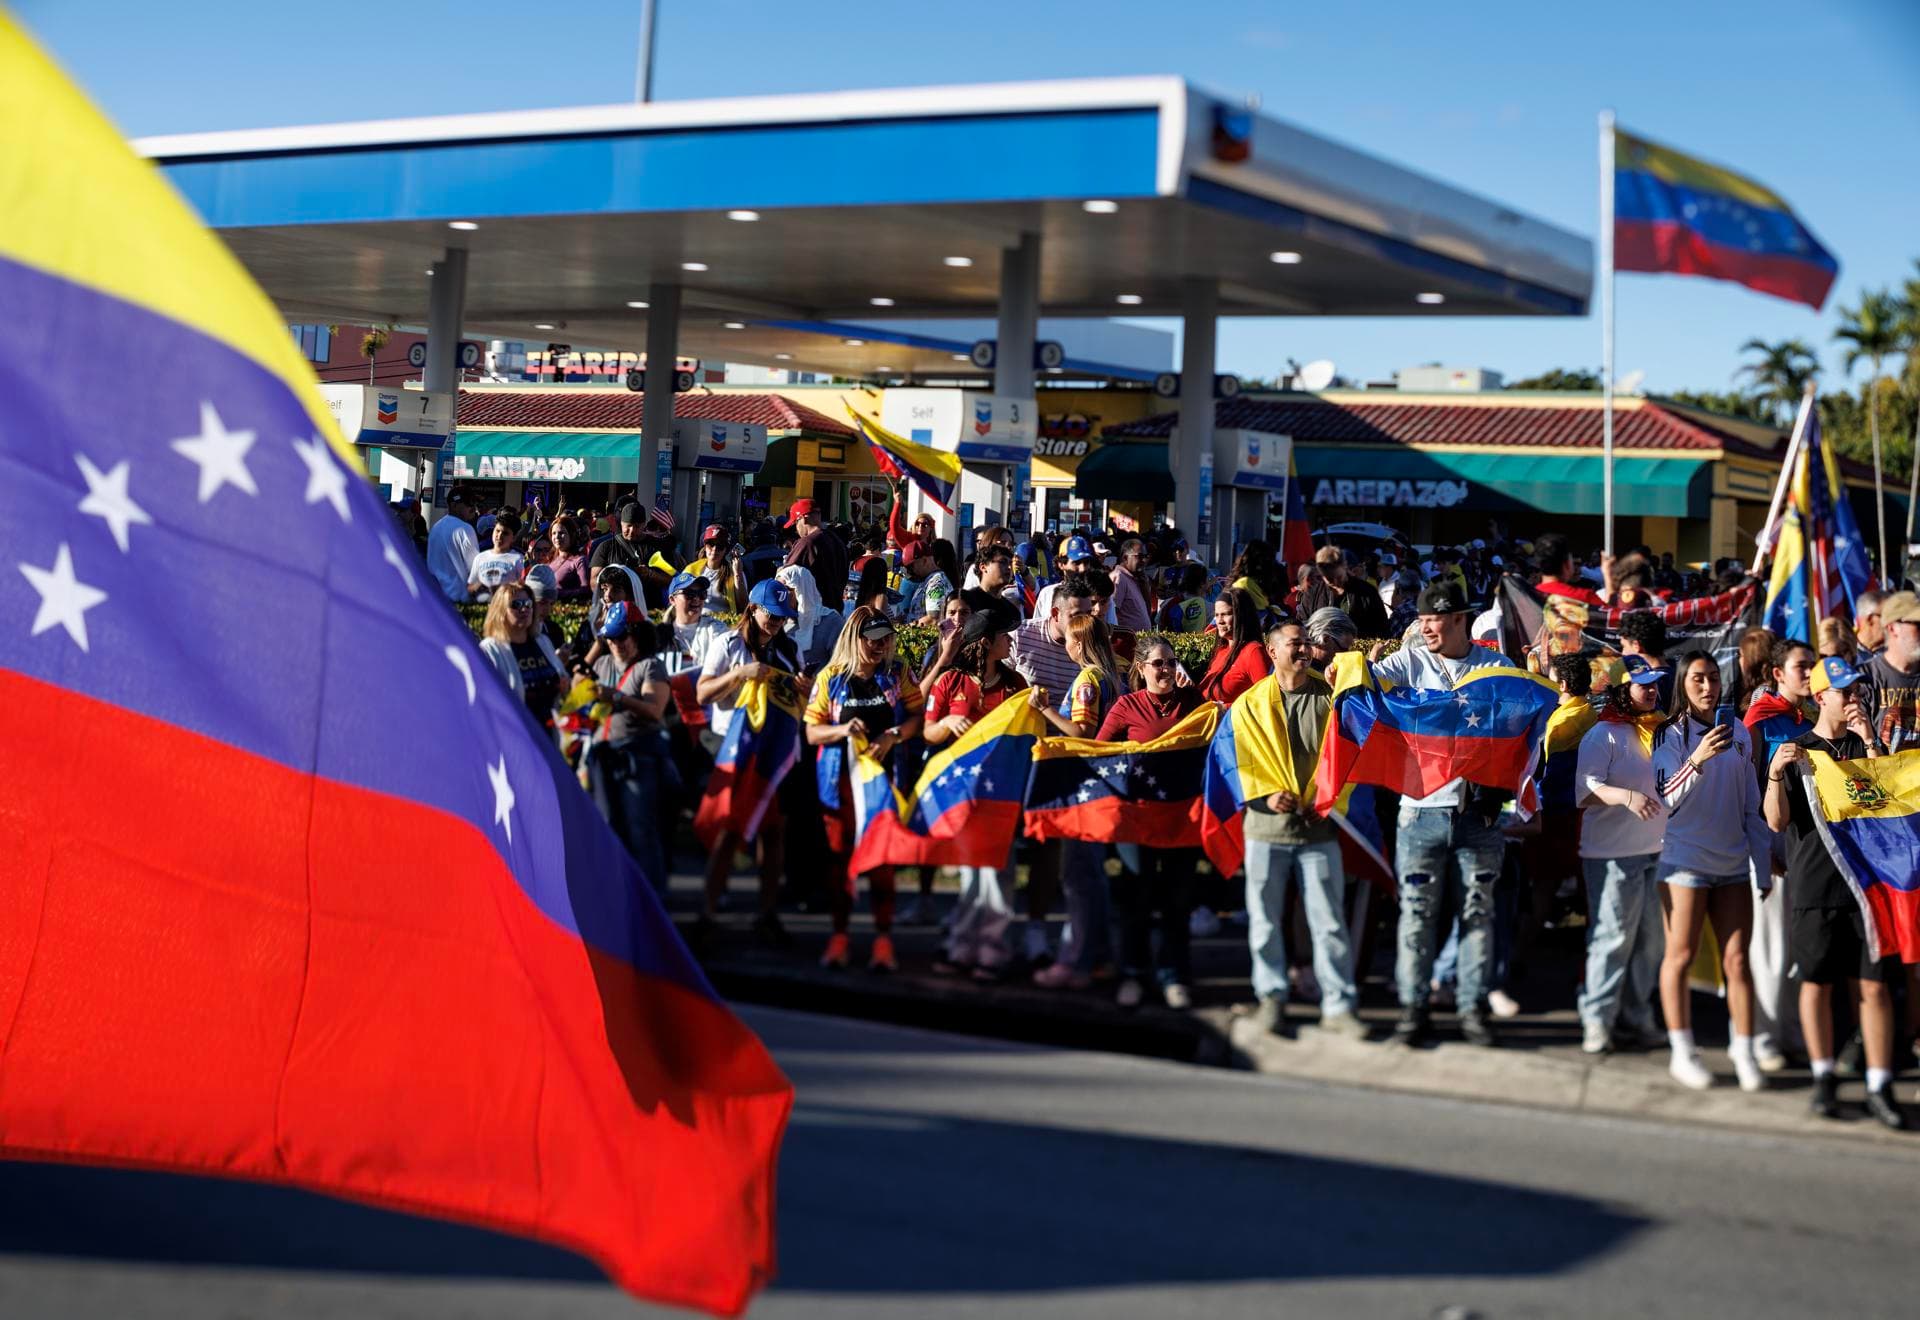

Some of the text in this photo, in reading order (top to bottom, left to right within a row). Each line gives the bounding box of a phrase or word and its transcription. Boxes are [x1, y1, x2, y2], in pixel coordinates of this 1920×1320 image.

[526, 351, 557, 374] EL
[420, 396, 430, 414] 7
[911, 406, 934, 418] Self
[1010, 404, 1020, 424] 3
[743, 428, 752, 443] 5
[1034, 436, 1088, 457] Store
[477, 455, 586, 481] AREPAZO
[1311, 479, 1469, 507] AREPAZO
